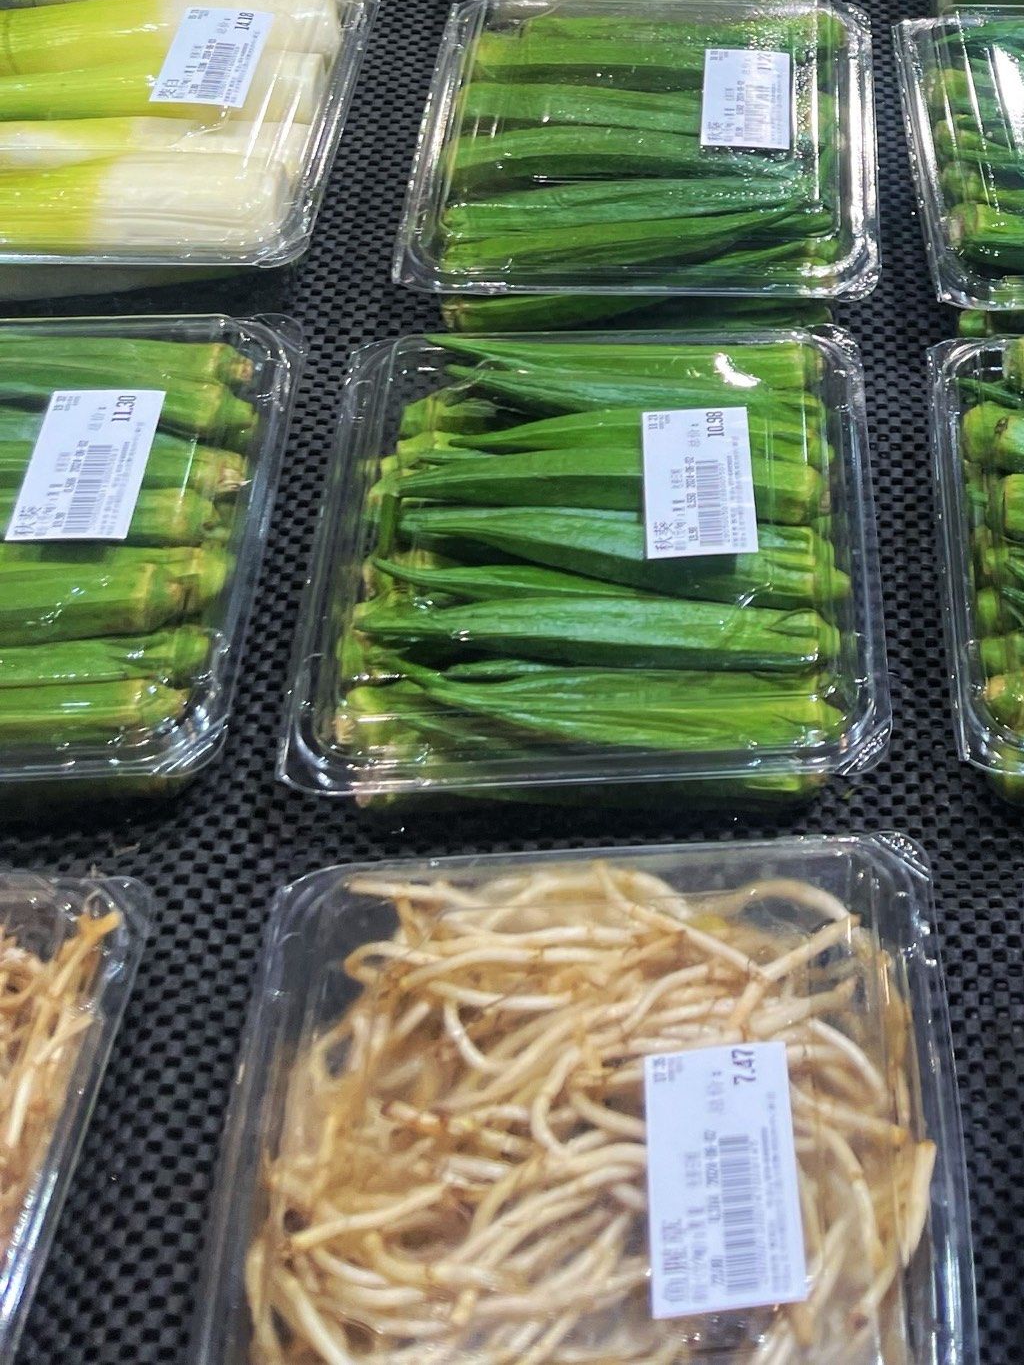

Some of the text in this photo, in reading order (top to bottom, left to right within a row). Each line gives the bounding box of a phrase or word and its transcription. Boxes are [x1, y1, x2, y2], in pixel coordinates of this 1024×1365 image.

[233, 12, 254, 30] 14.18
[111, 395, 136, 421] 11.30
[706, 411, 724, 437] 10.98
[12, 505, 42, 535] 秋葵
[652, 520, 674, 550] 秋葵
[731, 1047, 756, 1085] 7.47
